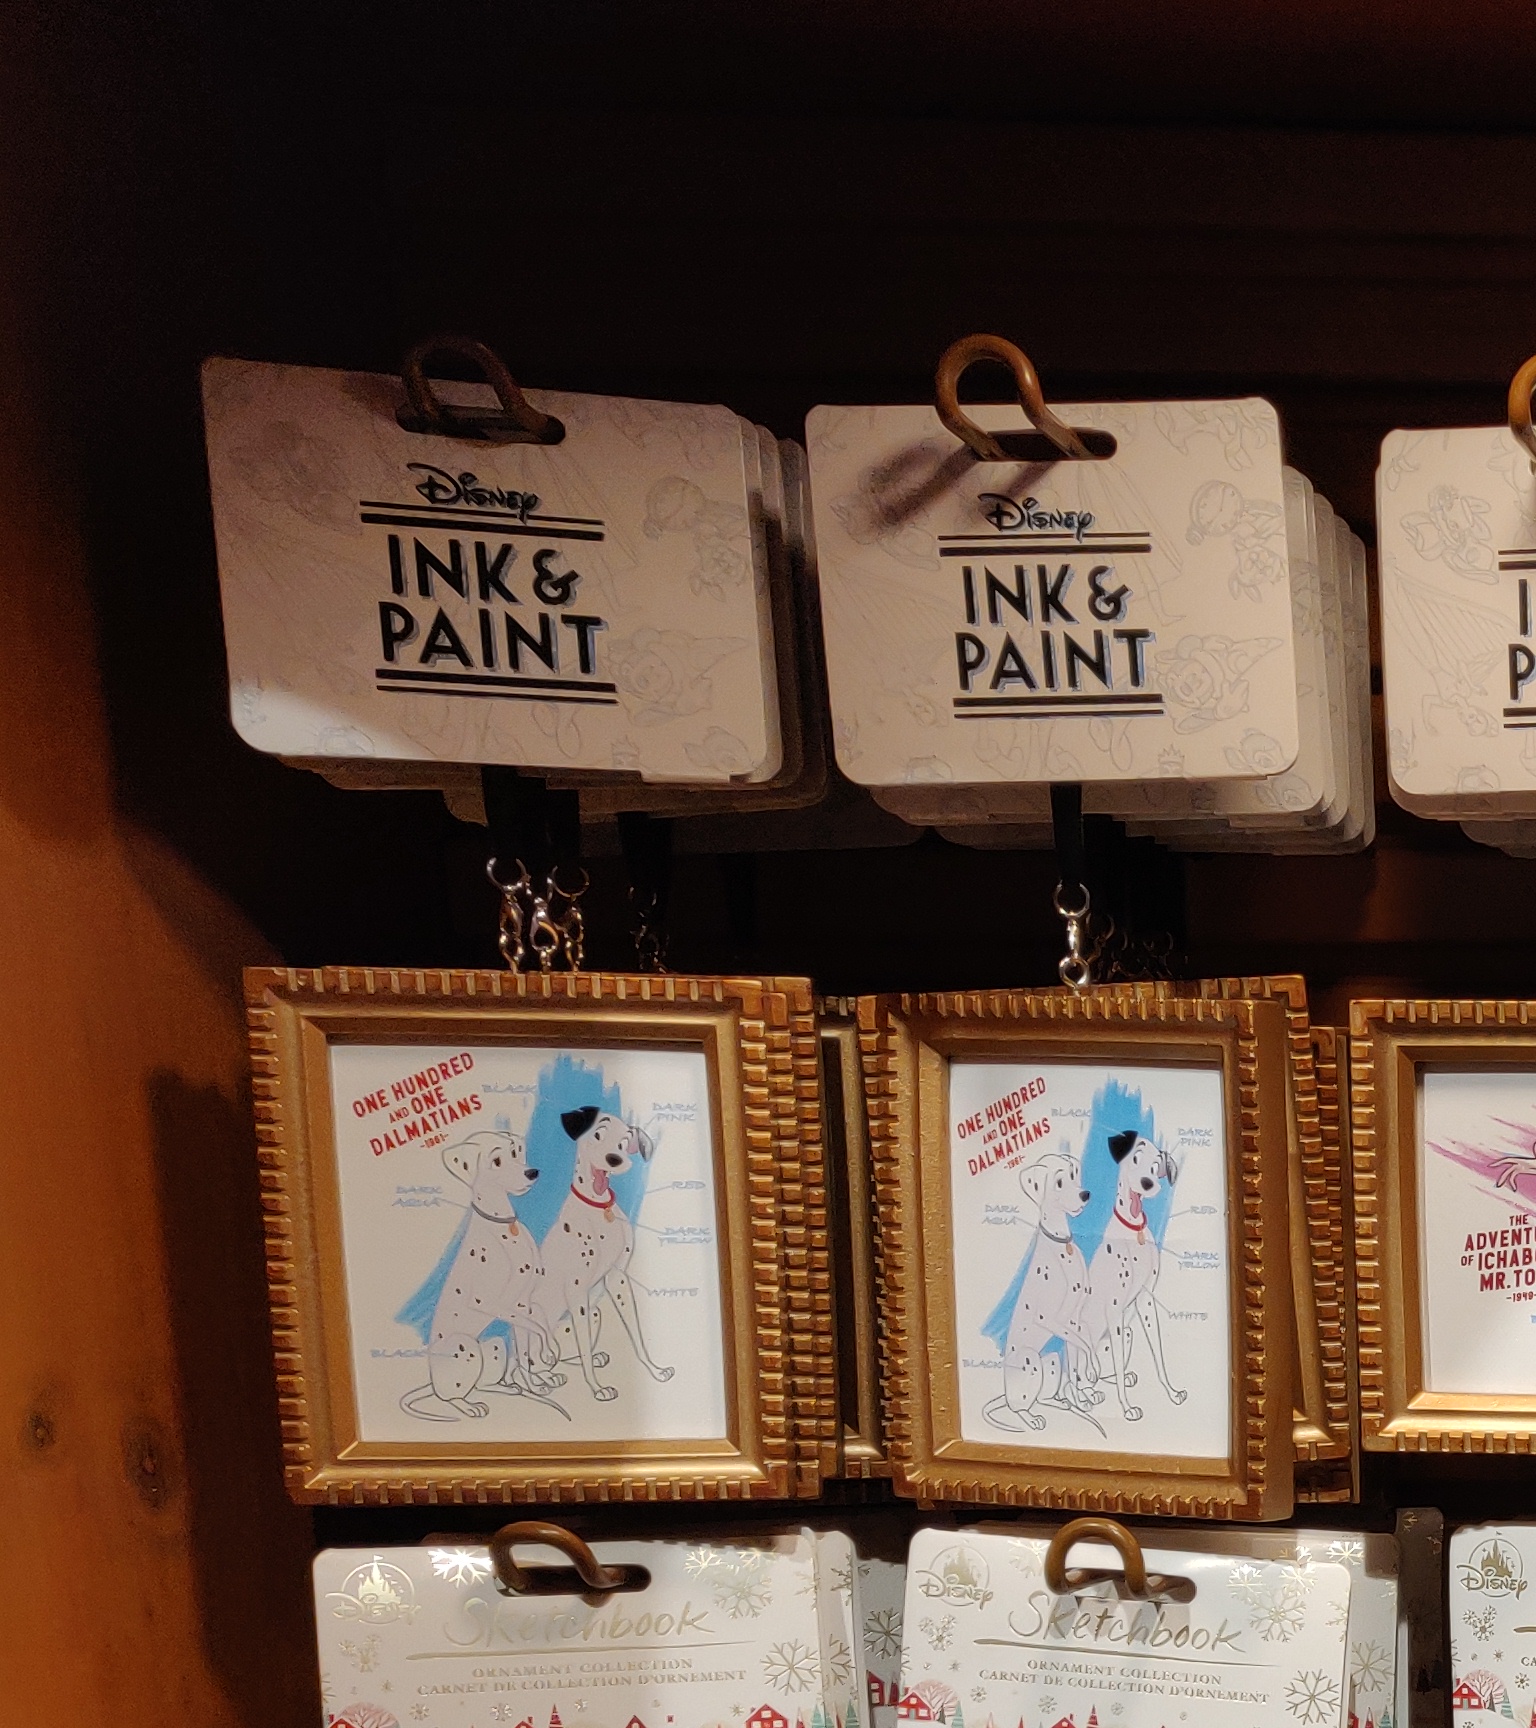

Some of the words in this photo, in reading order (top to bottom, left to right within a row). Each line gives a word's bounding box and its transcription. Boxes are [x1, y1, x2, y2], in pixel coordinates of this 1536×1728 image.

[387, 534, 523, 606] INK
[532, 548, 583, 608] &
[962, 563, 1080, 627] INK
[1088, 565, 1133, 623] &
[378, 601, 608, 675] PAINT
[955, 628, 1157, 692] PAINT
[352, 1092, 388, 1119] ONE
[394, 1051, 475, 1100] HUNDRED
[388, 1106, 409, 1126] AND
[411, 1087, 445, 1115] ONE
[957, 1116, 984, 1140] ONE
[987, 1077, 1046, 1125] HUNDRED
[369, 1093, 482, 1157] DALMATIANS
[968, 1117, 1051, 1177] DALMATIANS
[982, 1129, 998, 1145] AND
[999, 1110, 1026, 1137] ONE
[1509, 1215, 1528, 1226] THE
[1461, 1255, 1474, 1267] OF
[1479, 1270, 1512, 1291] MR.
[443, 1596, 716, 1647] Sketchbook
[1008, 1590, 1246, 1653] Sketchbook
